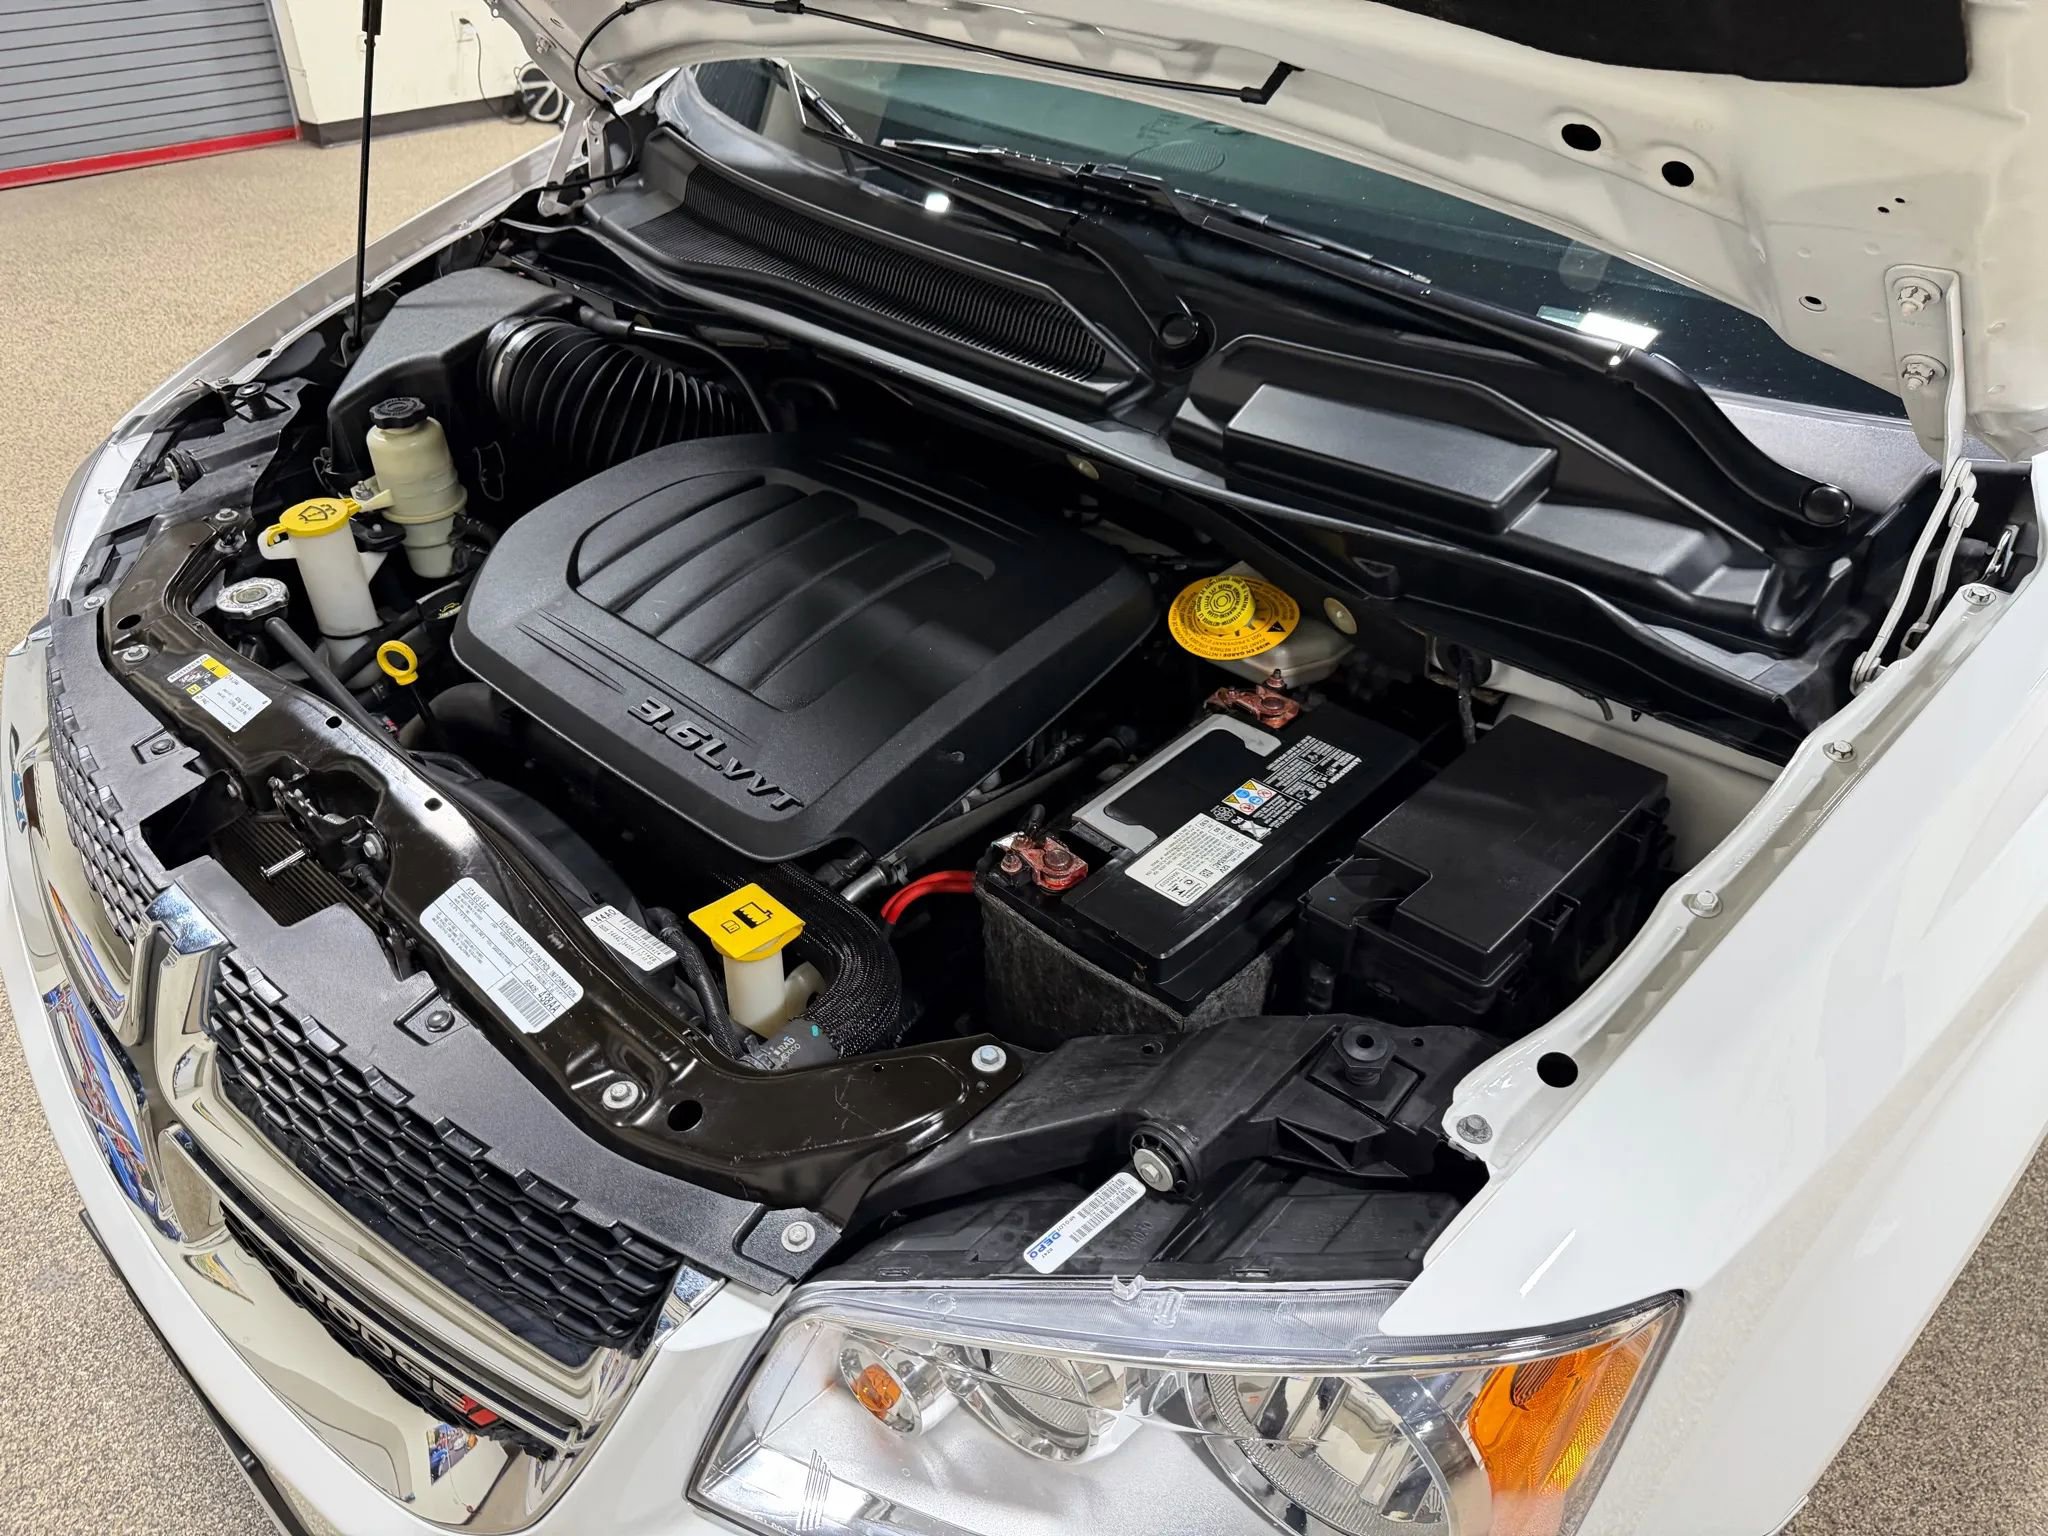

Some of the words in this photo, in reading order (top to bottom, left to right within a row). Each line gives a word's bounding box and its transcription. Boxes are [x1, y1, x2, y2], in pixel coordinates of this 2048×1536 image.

[1255, 642, 1270, 652] MISE
[1231, 816, 1244, 824] Pb
[1219, 865, 1231, 873] 12V
[498, 919, 517, 938] VEHICLE
[514, 935, 534, 955] EMISSION
[531, 953, 551, 972] CONTROL
[549, 971, 577, 998] INFORMATION
[538, 989, 561, 1014] 438AA
[1029, 1232, 1061, 1258] DEPO
[295, 1270, 469, 1413] DODGE
